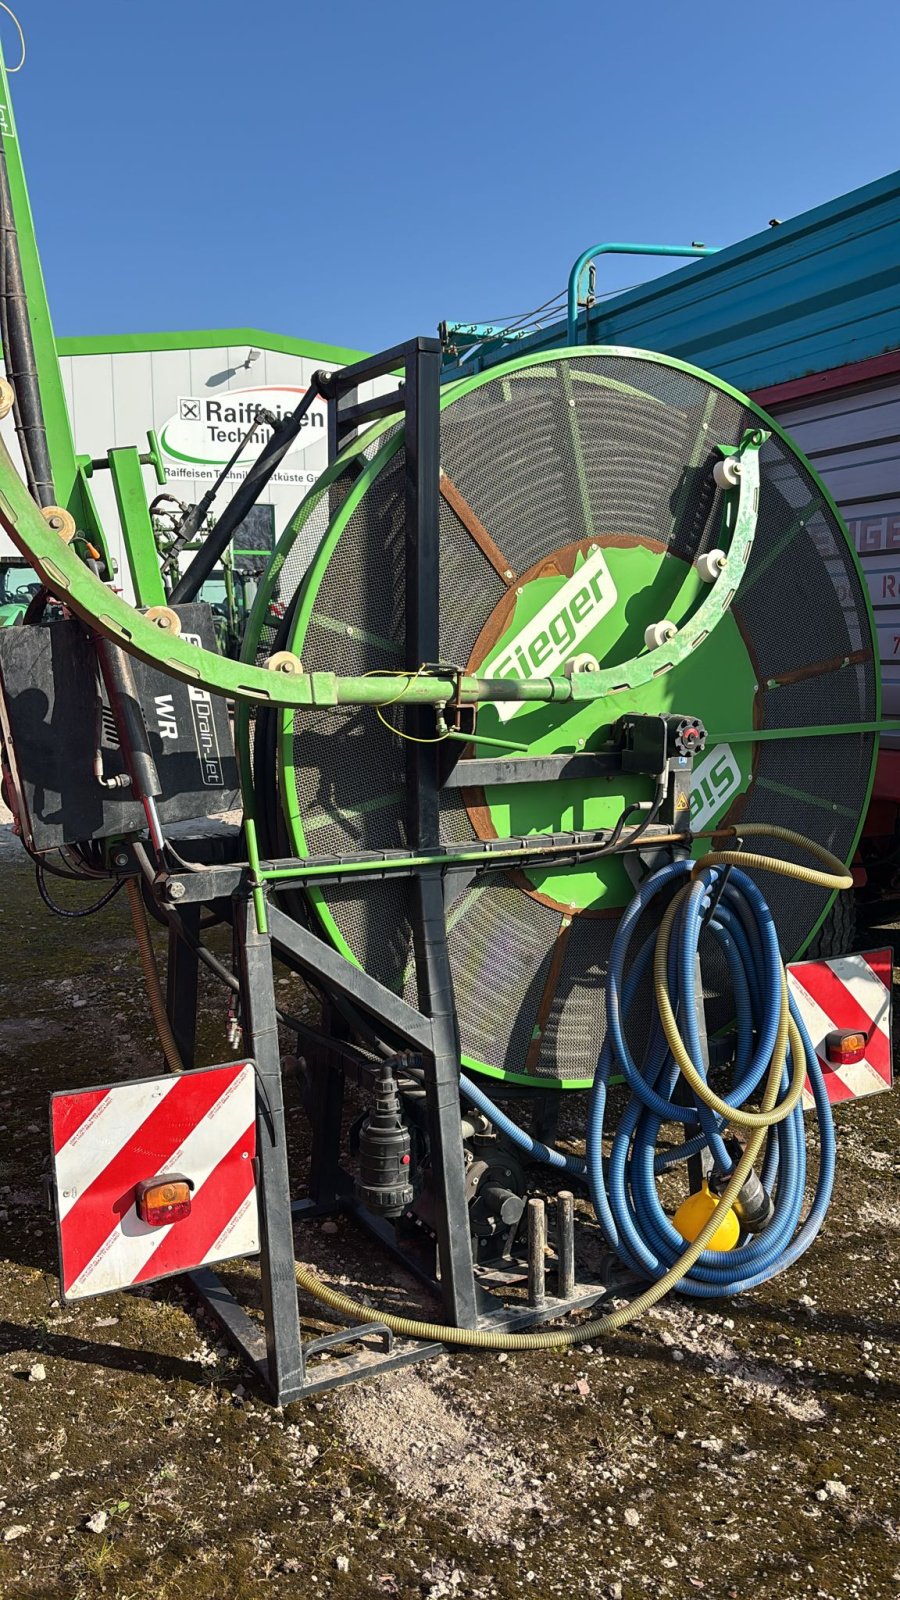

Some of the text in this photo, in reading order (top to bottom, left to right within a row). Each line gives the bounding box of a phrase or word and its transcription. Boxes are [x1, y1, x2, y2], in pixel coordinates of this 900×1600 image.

[206, 401, 324, 428] Raiffien
[164, 467, 213, 479] Raiffeisen
[214, 469, 248, 479] Tchni
[270, 472, 304, 482] stküste
[154, 694, 179, 740] WR
[196, 703, 219, 783] Drain-Jet
